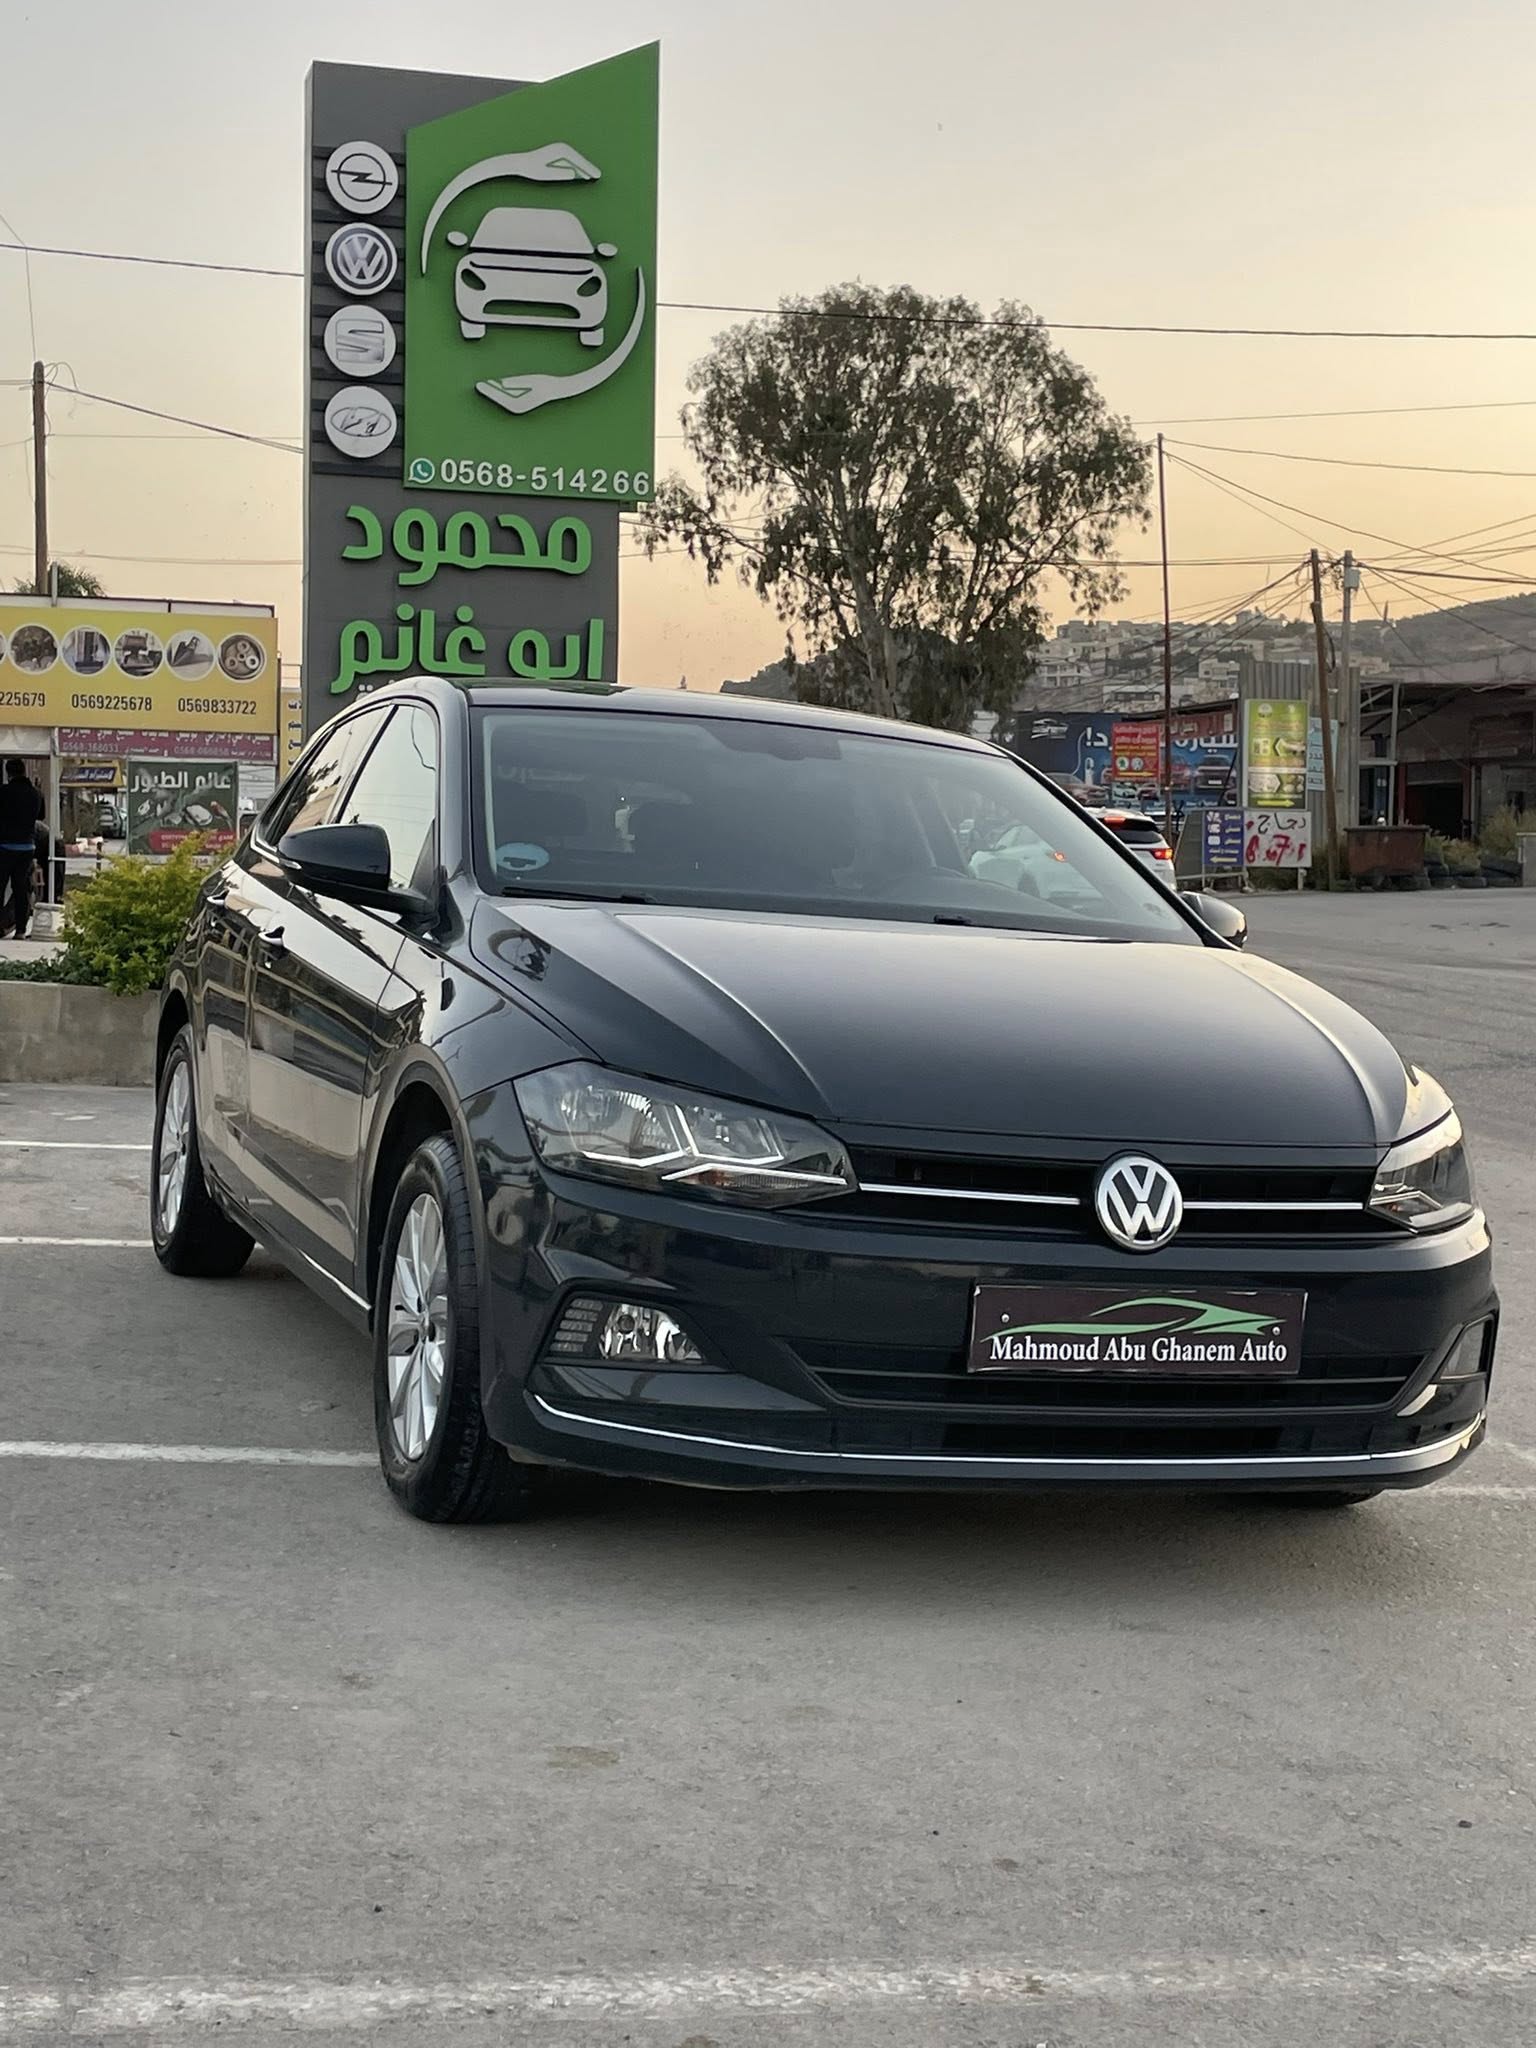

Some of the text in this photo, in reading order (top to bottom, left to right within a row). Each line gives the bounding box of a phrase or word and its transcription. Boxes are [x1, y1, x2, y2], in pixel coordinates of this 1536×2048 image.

[440, 458, 650, 496] 0568-514266
[342, 505, 593, 586] محمود
[331, 603, 487, 693] غانم
[71, 693, 153, 711] 0569225678
[177, 697, 258, 716] 0569833722
[130, 770, 189, 793] الطيور
[194, 771, 231, 791] عالم
[989, 1335, 1288, 1363] Mahmoud Abu Ghanem Auto
